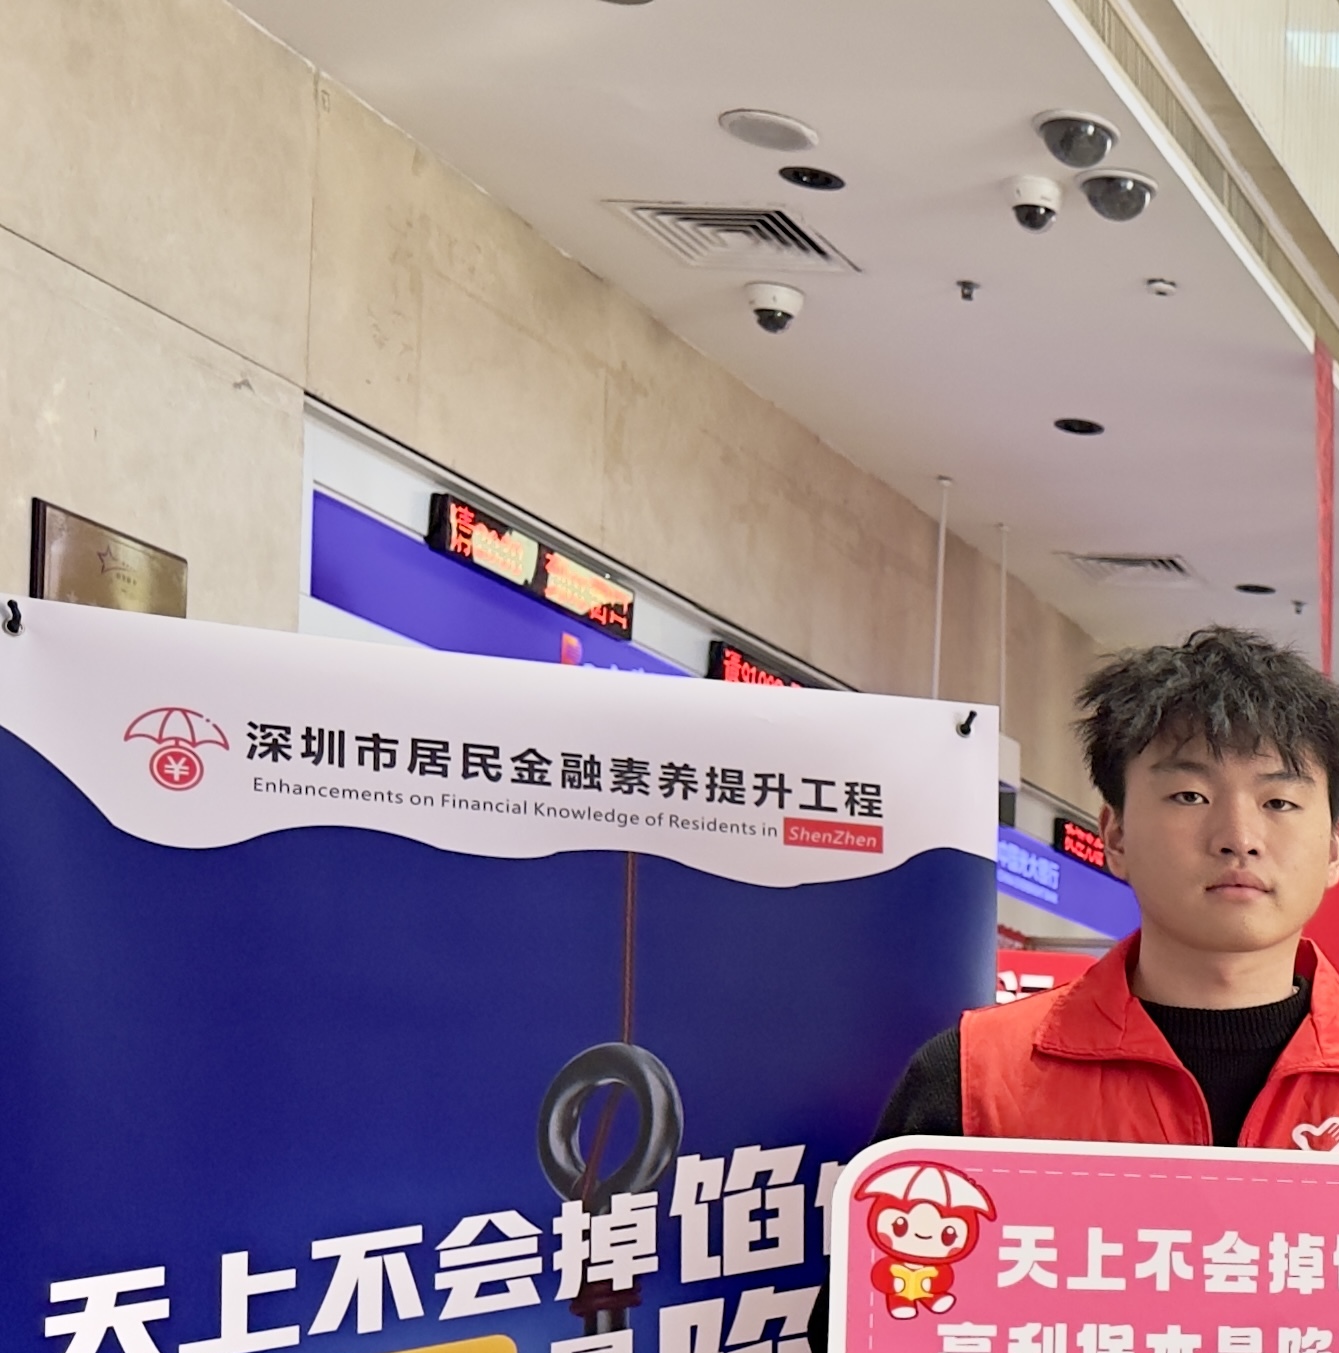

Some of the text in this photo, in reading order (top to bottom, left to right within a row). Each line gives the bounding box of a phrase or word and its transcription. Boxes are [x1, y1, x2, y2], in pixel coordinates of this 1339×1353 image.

[246, 720, 884, 819] 深圳市居民金融素养提升工程
[253, 777, 877, 847] Enhancements on Financial Knowledge of Residents in ShenZhen
